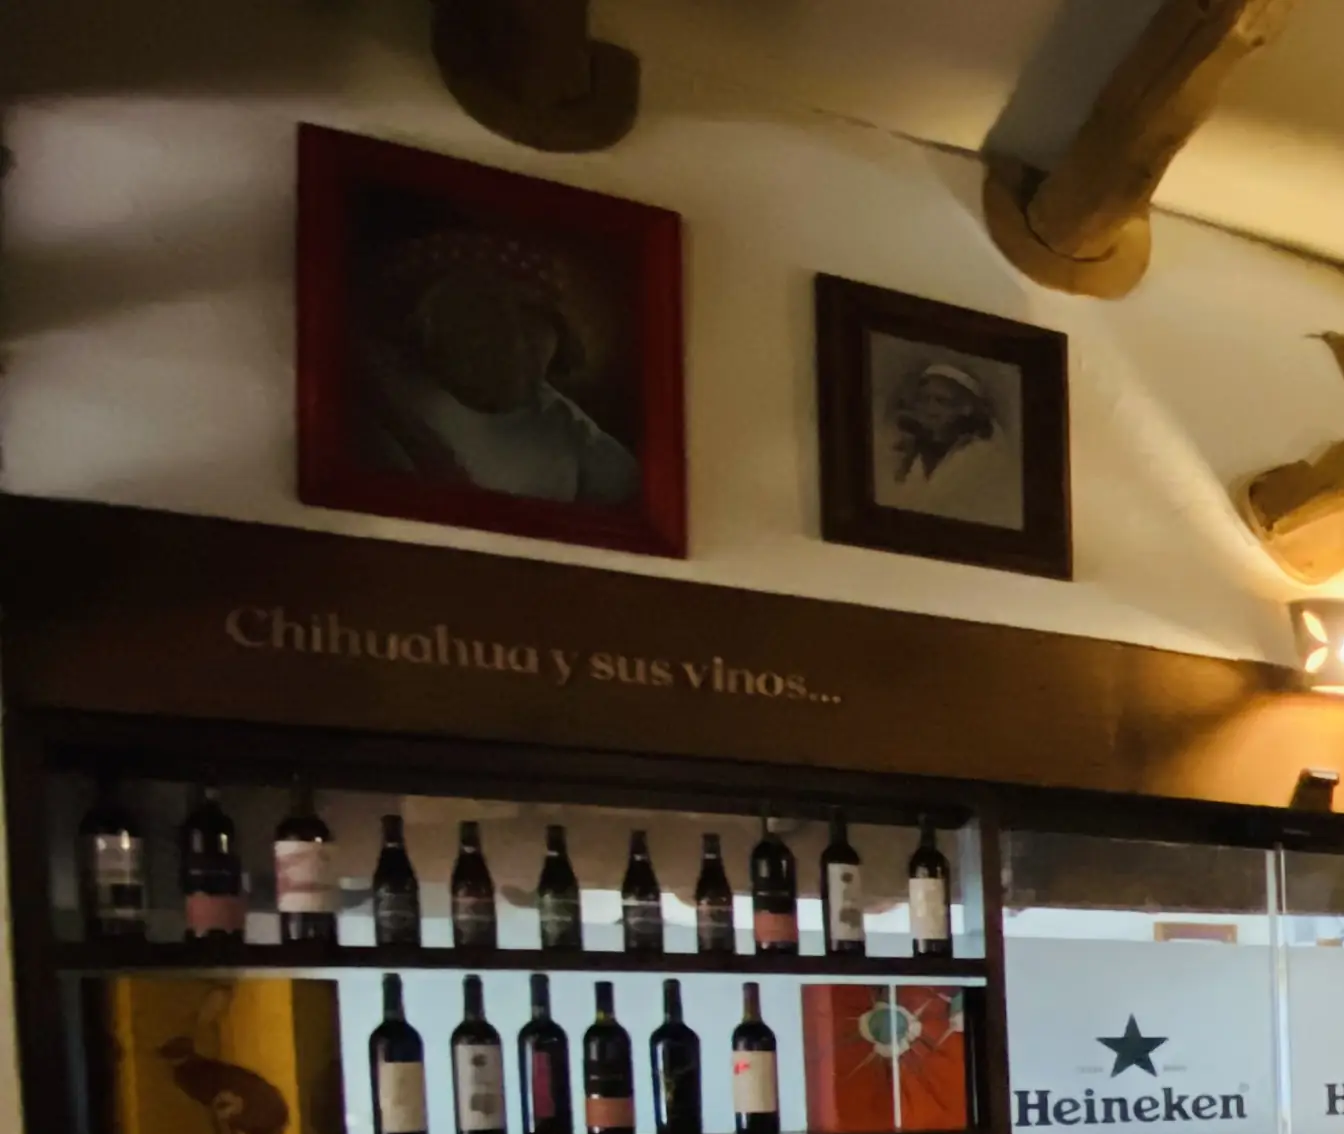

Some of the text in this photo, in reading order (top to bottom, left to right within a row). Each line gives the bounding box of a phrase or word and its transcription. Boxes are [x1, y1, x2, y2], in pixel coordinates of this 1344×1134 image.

[225, 607, 539, 674] Chihuahua
[549, 647, 578, 686] y
[590, 650, 674, 685] sus
[1014, 1086, 1247, 1126] Heineken
